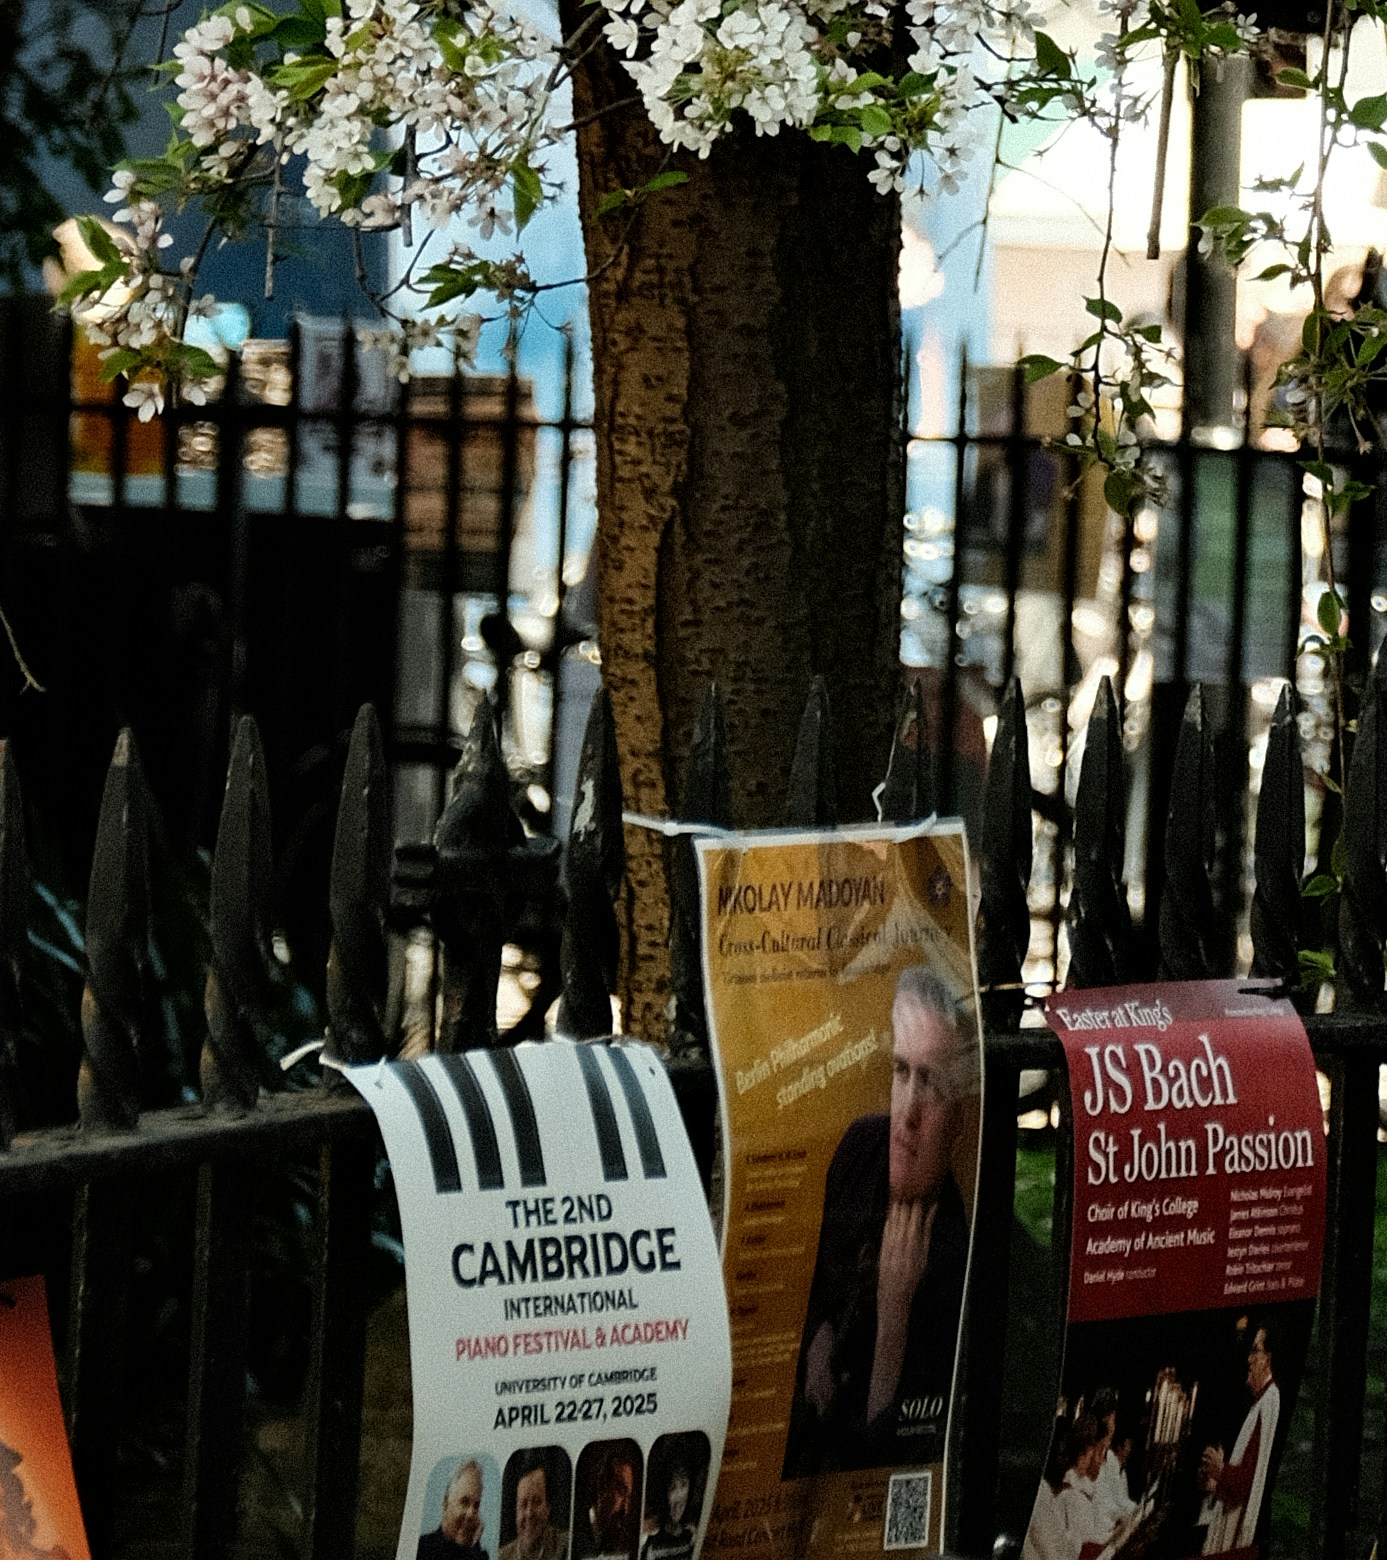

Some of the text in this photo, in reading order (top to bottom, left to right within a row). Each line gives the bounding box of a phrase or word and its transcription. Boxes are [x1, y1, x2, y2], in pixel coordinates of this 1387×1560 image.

[799, 875, 886, 909] MADOYAN
[1056, 999, 1173, 1031] Easter at King's
[1084, 1034, 1238, 1116] JS Bach
[1087, 1114, 1314, 1185] St John Passion
[505, 1193, 613, 1229] THE 2ND
[1087, 1196, 1199, 1223] Choir of King's College
[451, 1227, 681, 1289] CAMBRIDGE
[1085, 1227, 1215, 1257] Academy of Ancient Music
[504, 1288, 639, 1321] INTERNATIONAL
[455, 1318, 689, 1361] PIANO FESTIVAL & ACADEMY
[495, 1367, 657, 1396] UNIVERSITY OF CAMBRIDGE
[494, 1402, 551, 1430] APRIL
[612, 1393, 658, 1418] 2025
[901, 1395, 943, 1421] SOLO
